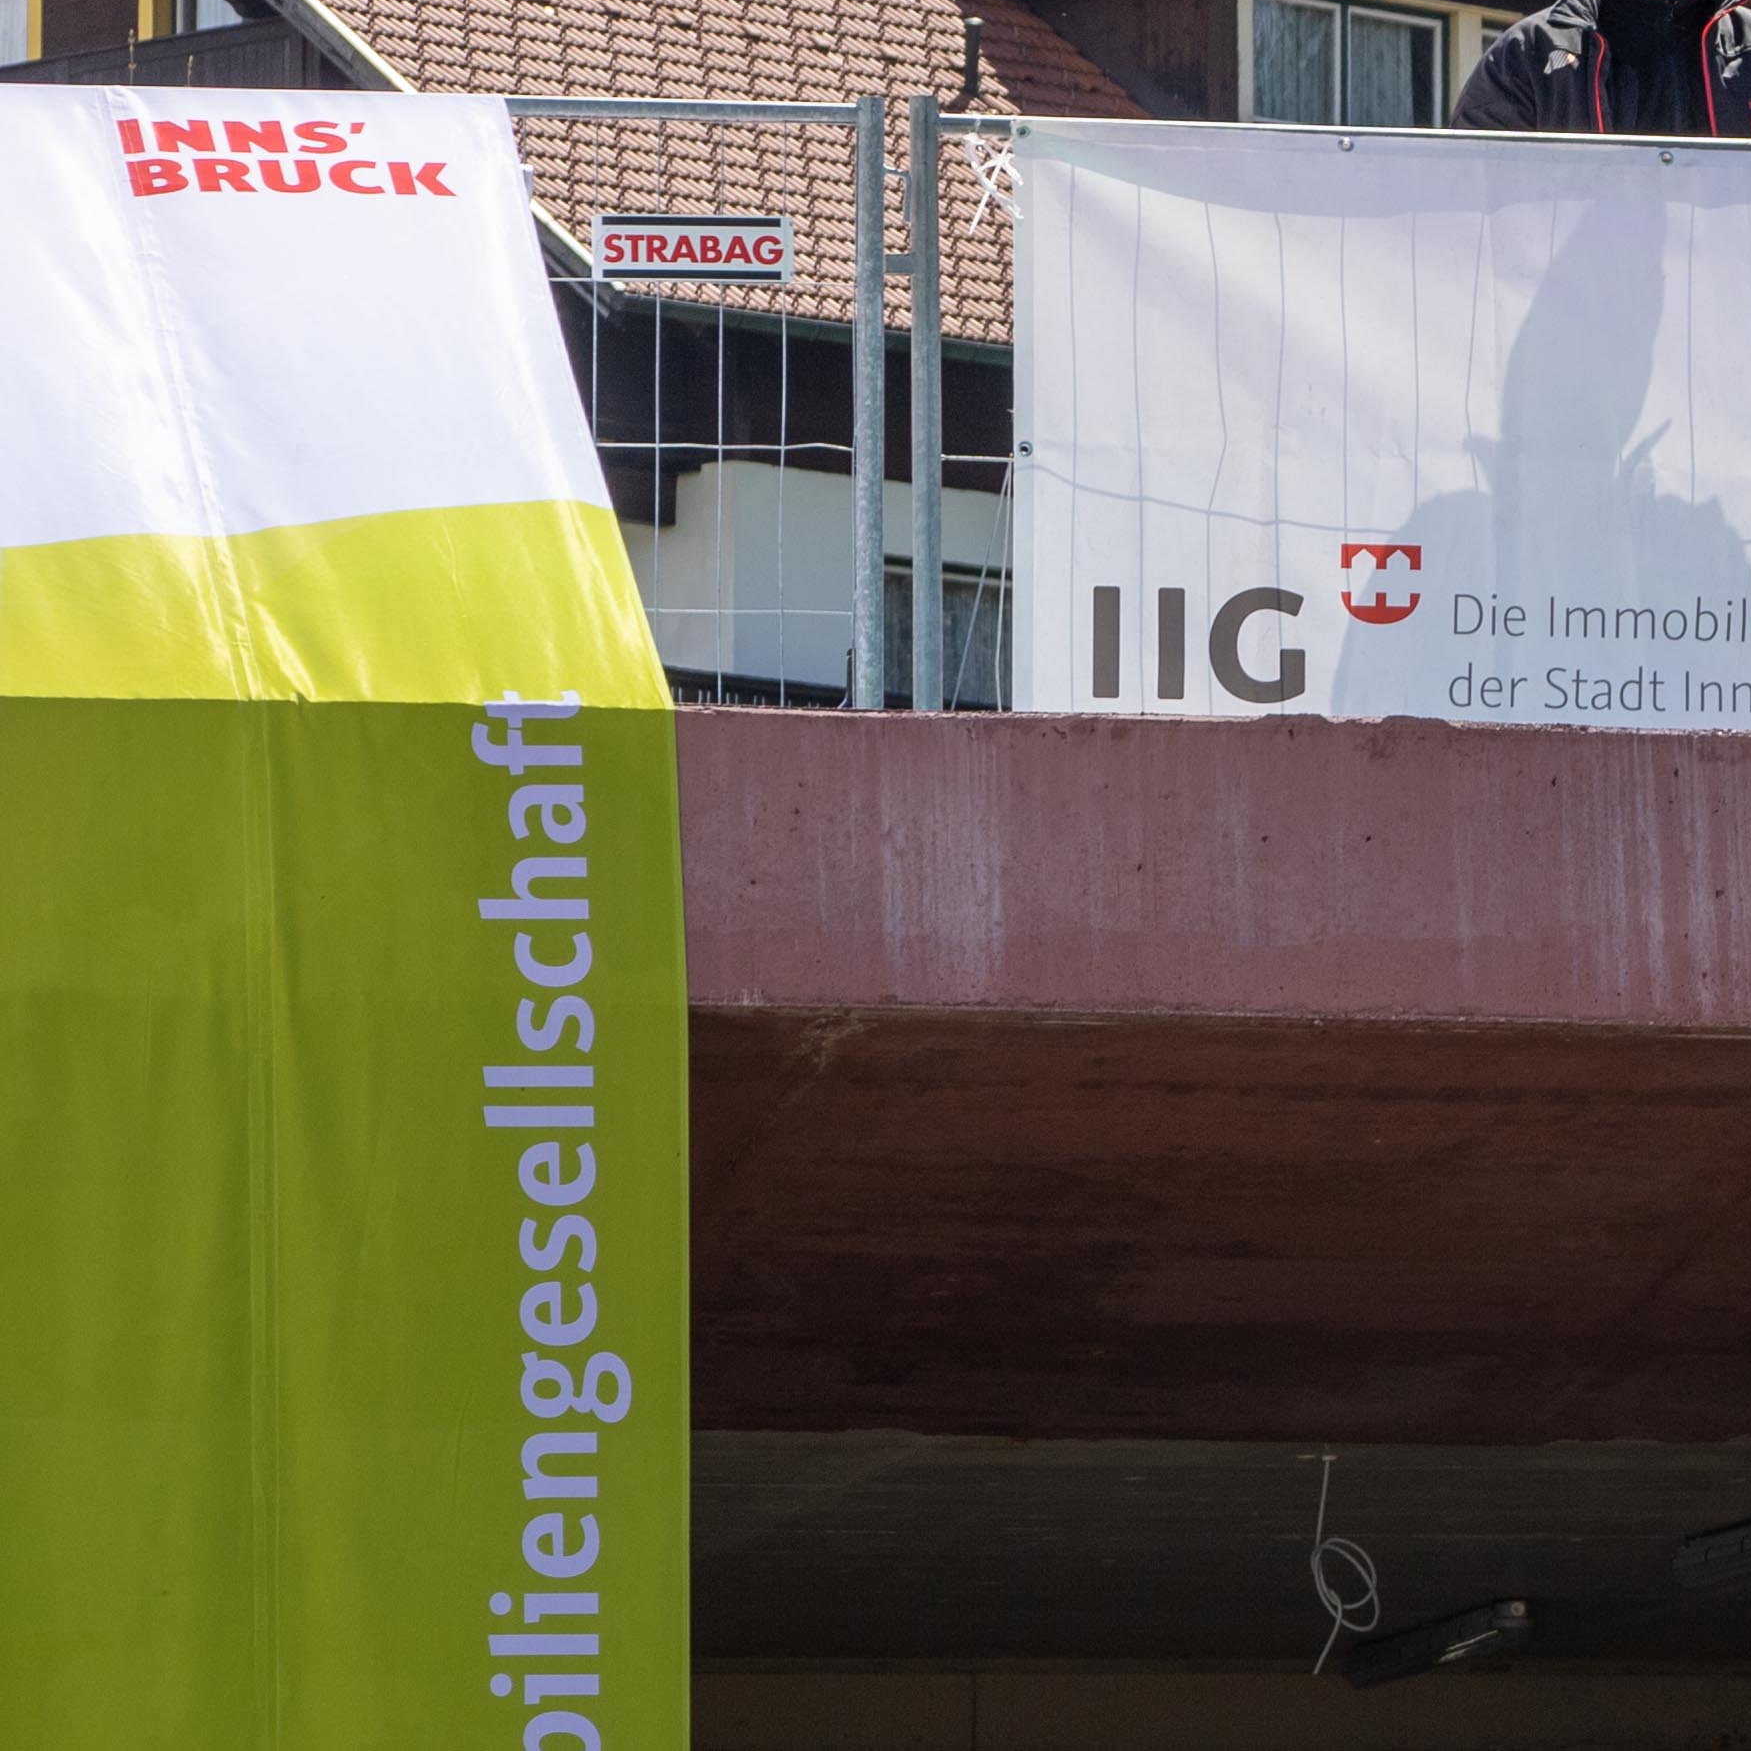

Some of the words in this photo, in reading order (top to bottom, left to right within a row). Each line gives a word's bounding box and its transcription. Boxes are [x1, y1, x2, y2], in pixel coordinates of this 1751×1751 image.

[124, 158, 456, 197] BRUCK
[603, 233, 785, 265] STRABAG
[1452, 593, 1527, 638] Die
[1092, 586, 1306, 704] IIG
[1448, 661, 1529, 710] der
[1543, 664, 1667, 713] Stadt
